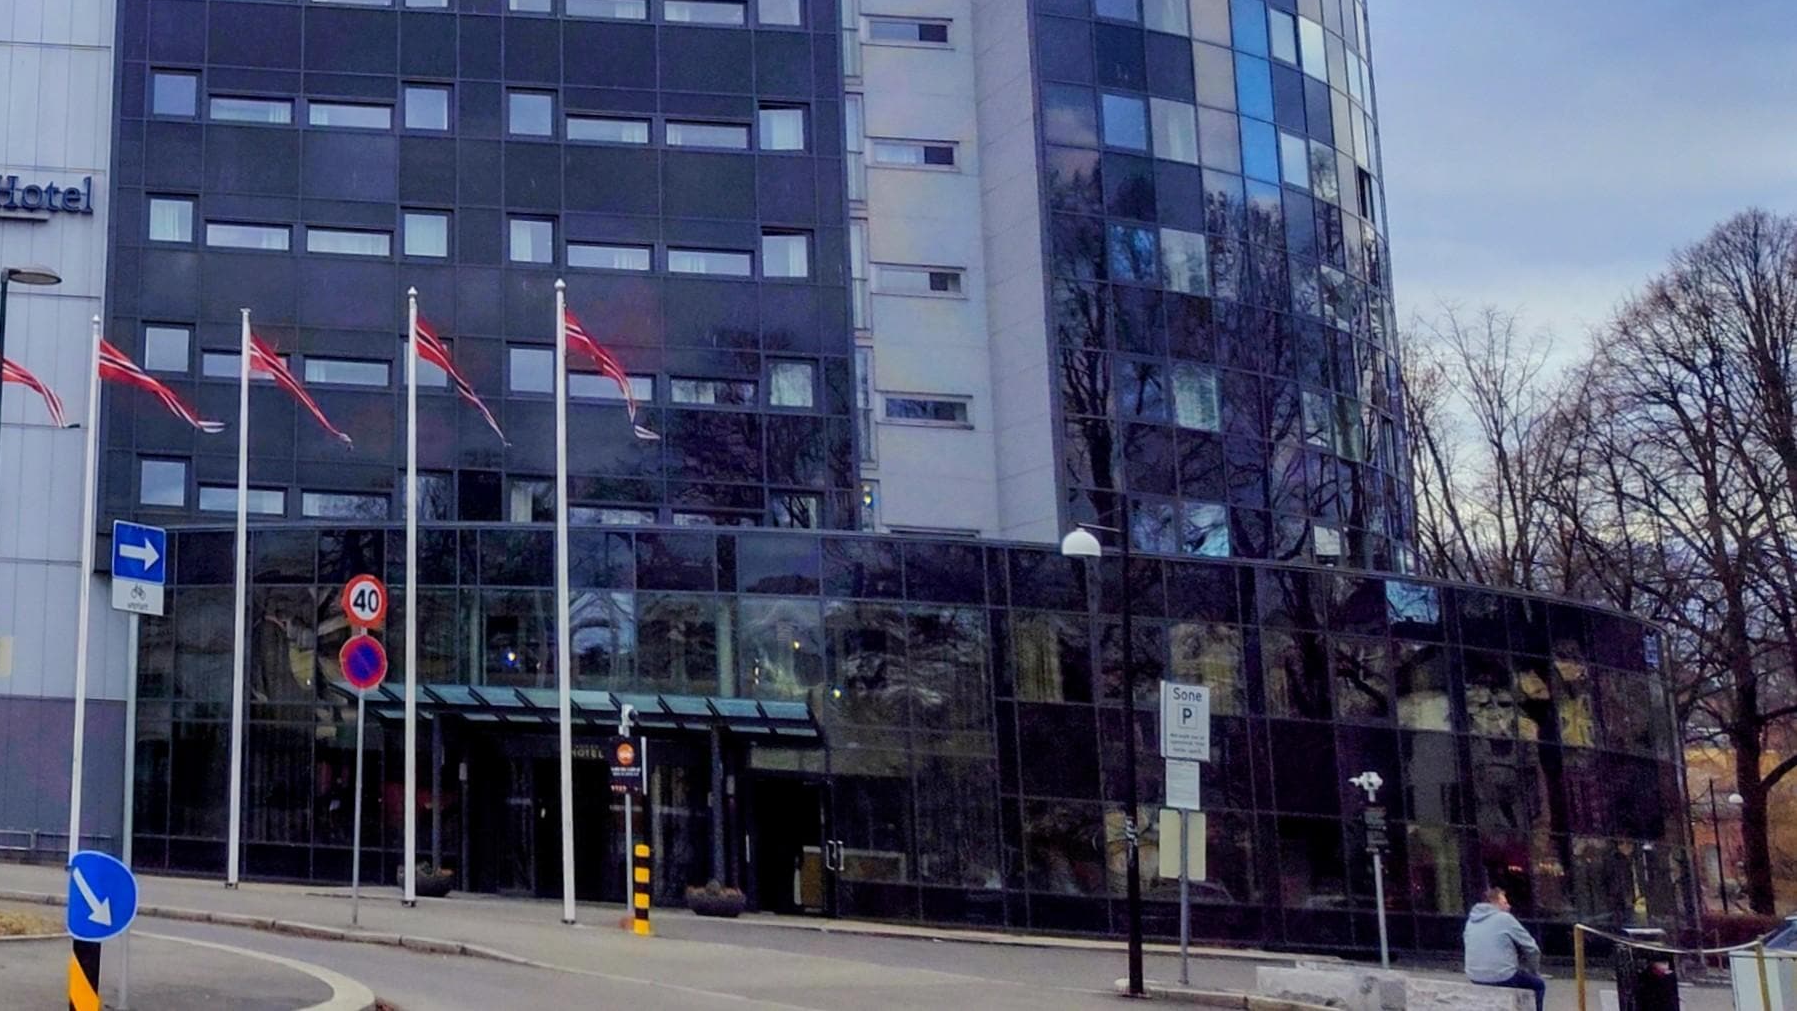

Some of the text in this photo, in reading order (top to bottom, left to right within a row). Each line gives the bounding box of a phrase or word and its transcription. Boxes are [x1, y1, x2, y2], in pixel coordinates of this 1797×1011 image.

[353, 589, 380, 613] 40
[1173, 687, 1203, 702] Sone
[1182, 708, 1192, 725] P
